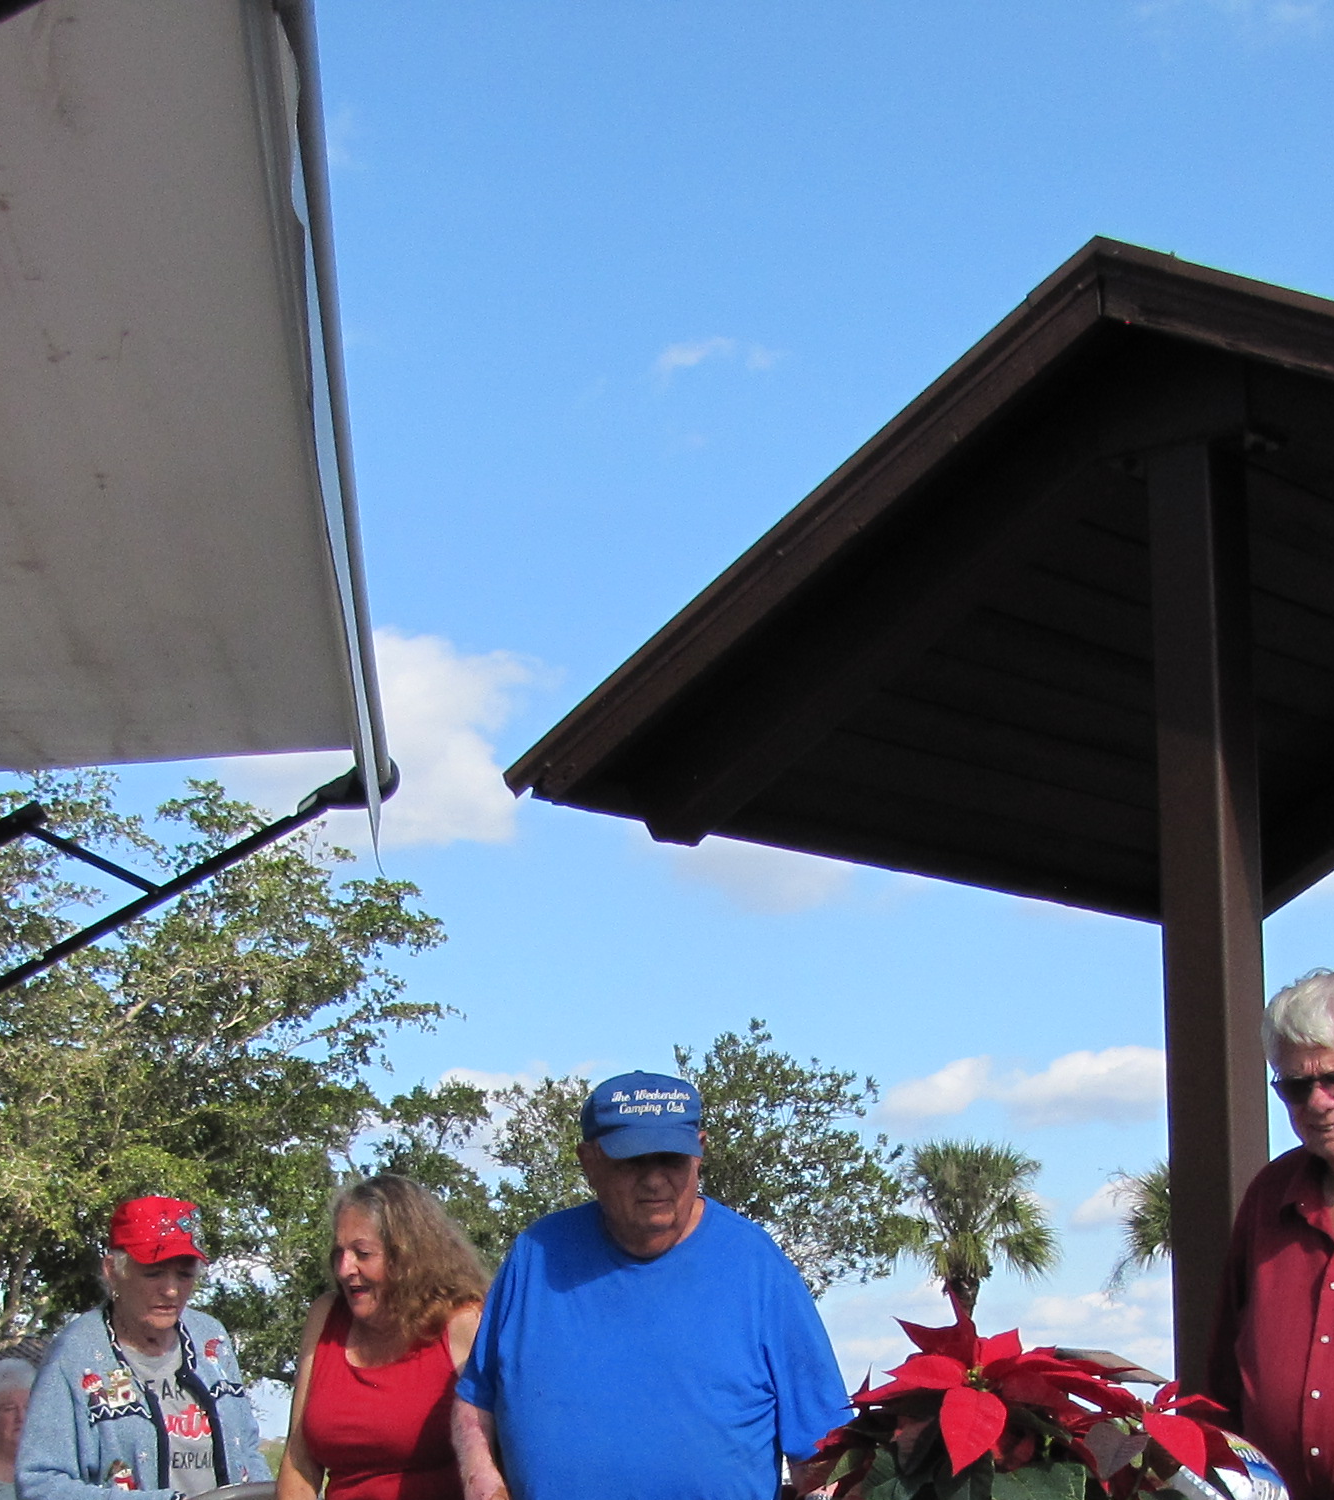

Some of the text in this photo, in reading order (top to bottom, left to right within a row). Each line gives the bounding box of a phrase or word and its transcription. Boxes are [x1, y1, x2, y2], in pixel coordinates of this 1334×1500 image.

[611, 1091, 631, 1102] The
[619, 1101, 686, 1116] Camping Club
